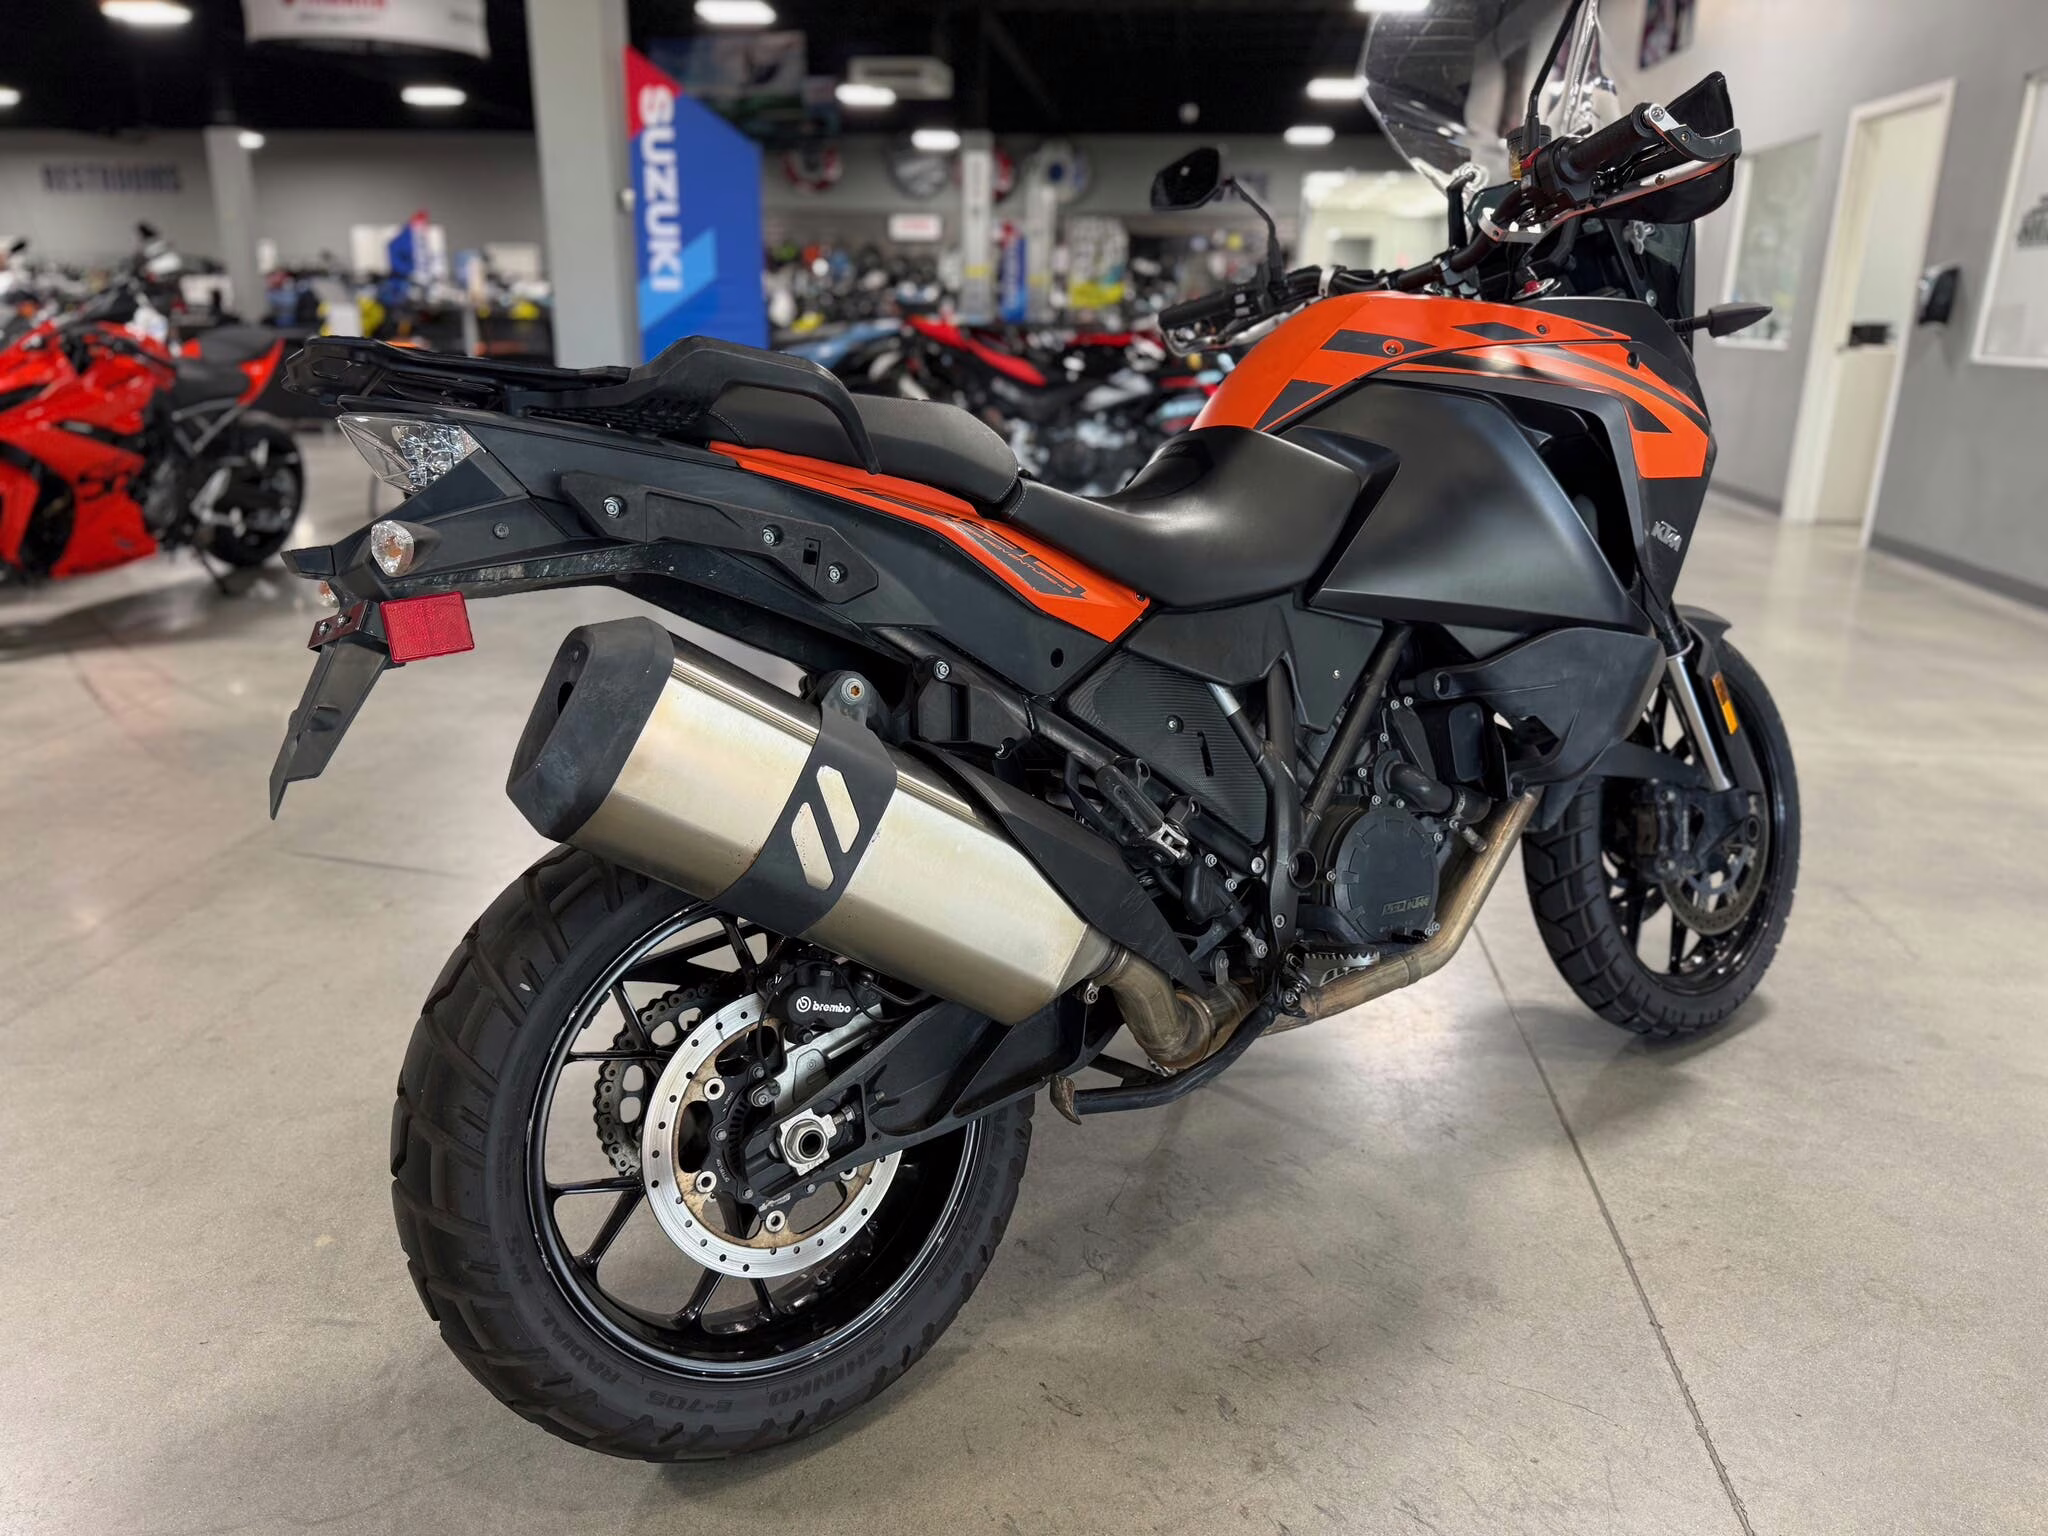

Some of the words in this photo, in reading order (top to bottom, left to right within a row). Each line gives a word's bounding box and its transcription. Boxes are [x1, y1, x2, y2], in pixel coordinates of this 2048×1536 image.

[638, 84, 683, 292] SUZUKI
[1651, 521, 1682, 552] KTM
[813, 1001, 851, 1013] brembo
[768, 1343, 886, 1407] SHINKO
